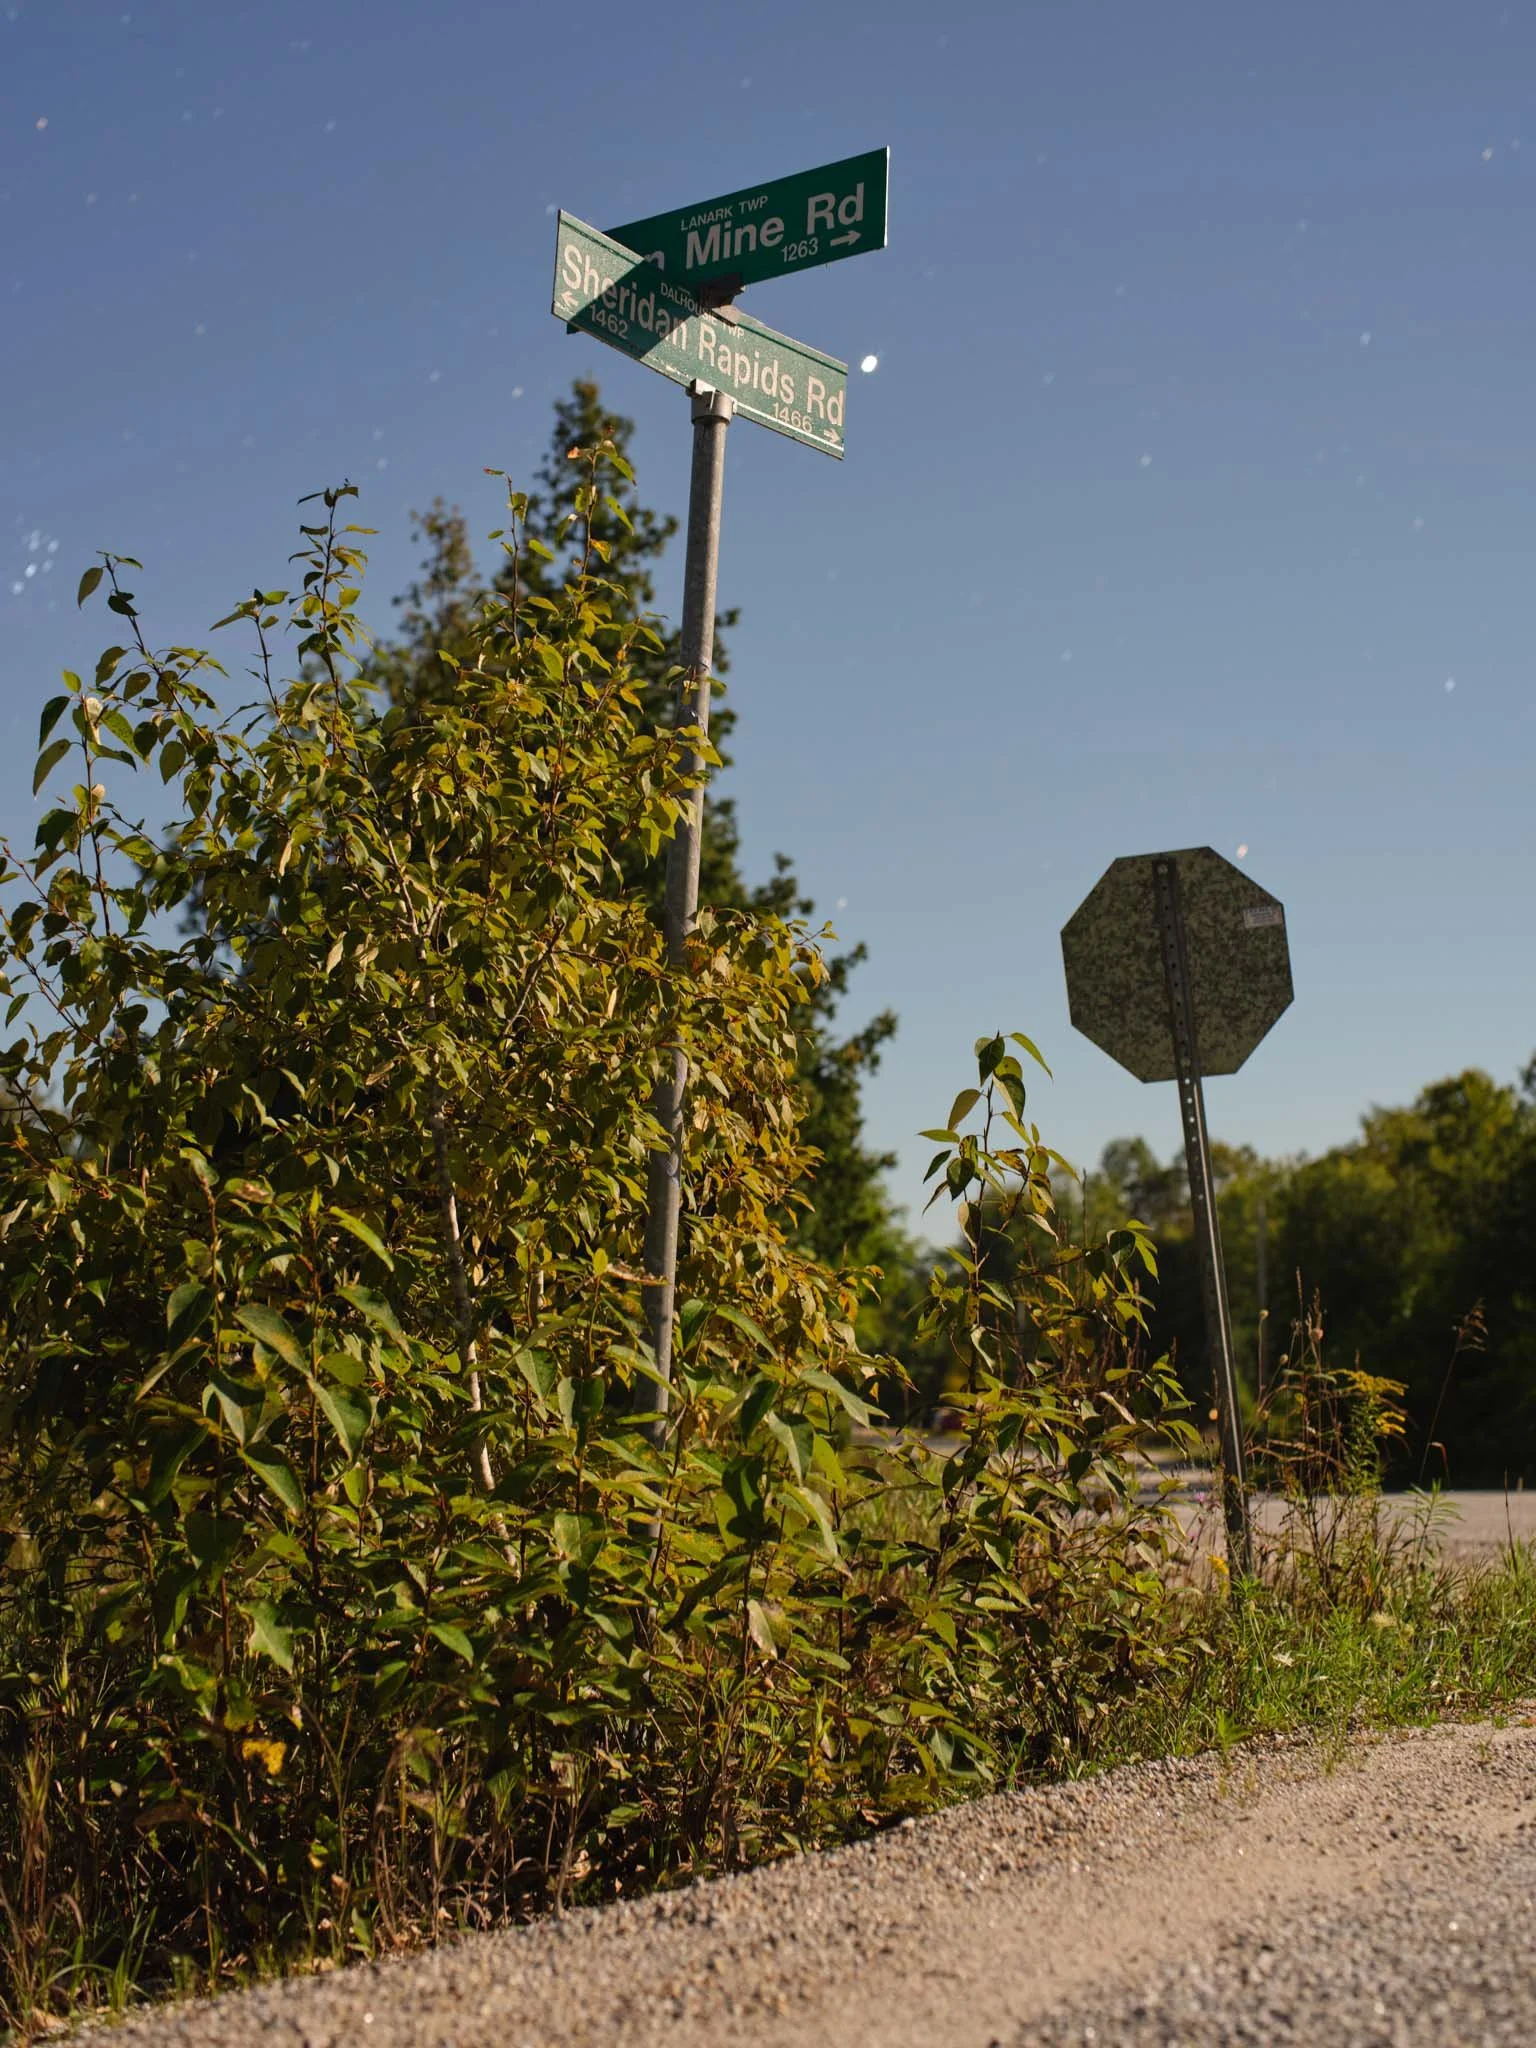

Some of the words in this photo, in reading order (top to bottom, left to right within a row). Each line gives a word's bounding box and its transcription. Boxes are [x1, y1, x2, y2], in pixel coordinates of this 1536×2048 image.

[681, 205, 734, 232] LANARK
[738, 195, 769, 214] TWP
[686, 216, 786, 270] Mine
[806, 183, 865, 236] Rd
[782, 237, 819, 264] 1263
[562, 245, 687, 351] Sheridan
[698, 323, 795, 404] Rapids
[807, 376, 845, 428] Rd
[589, 304, 629, 340] 1462
[772, 403, 813, 432] 1466
